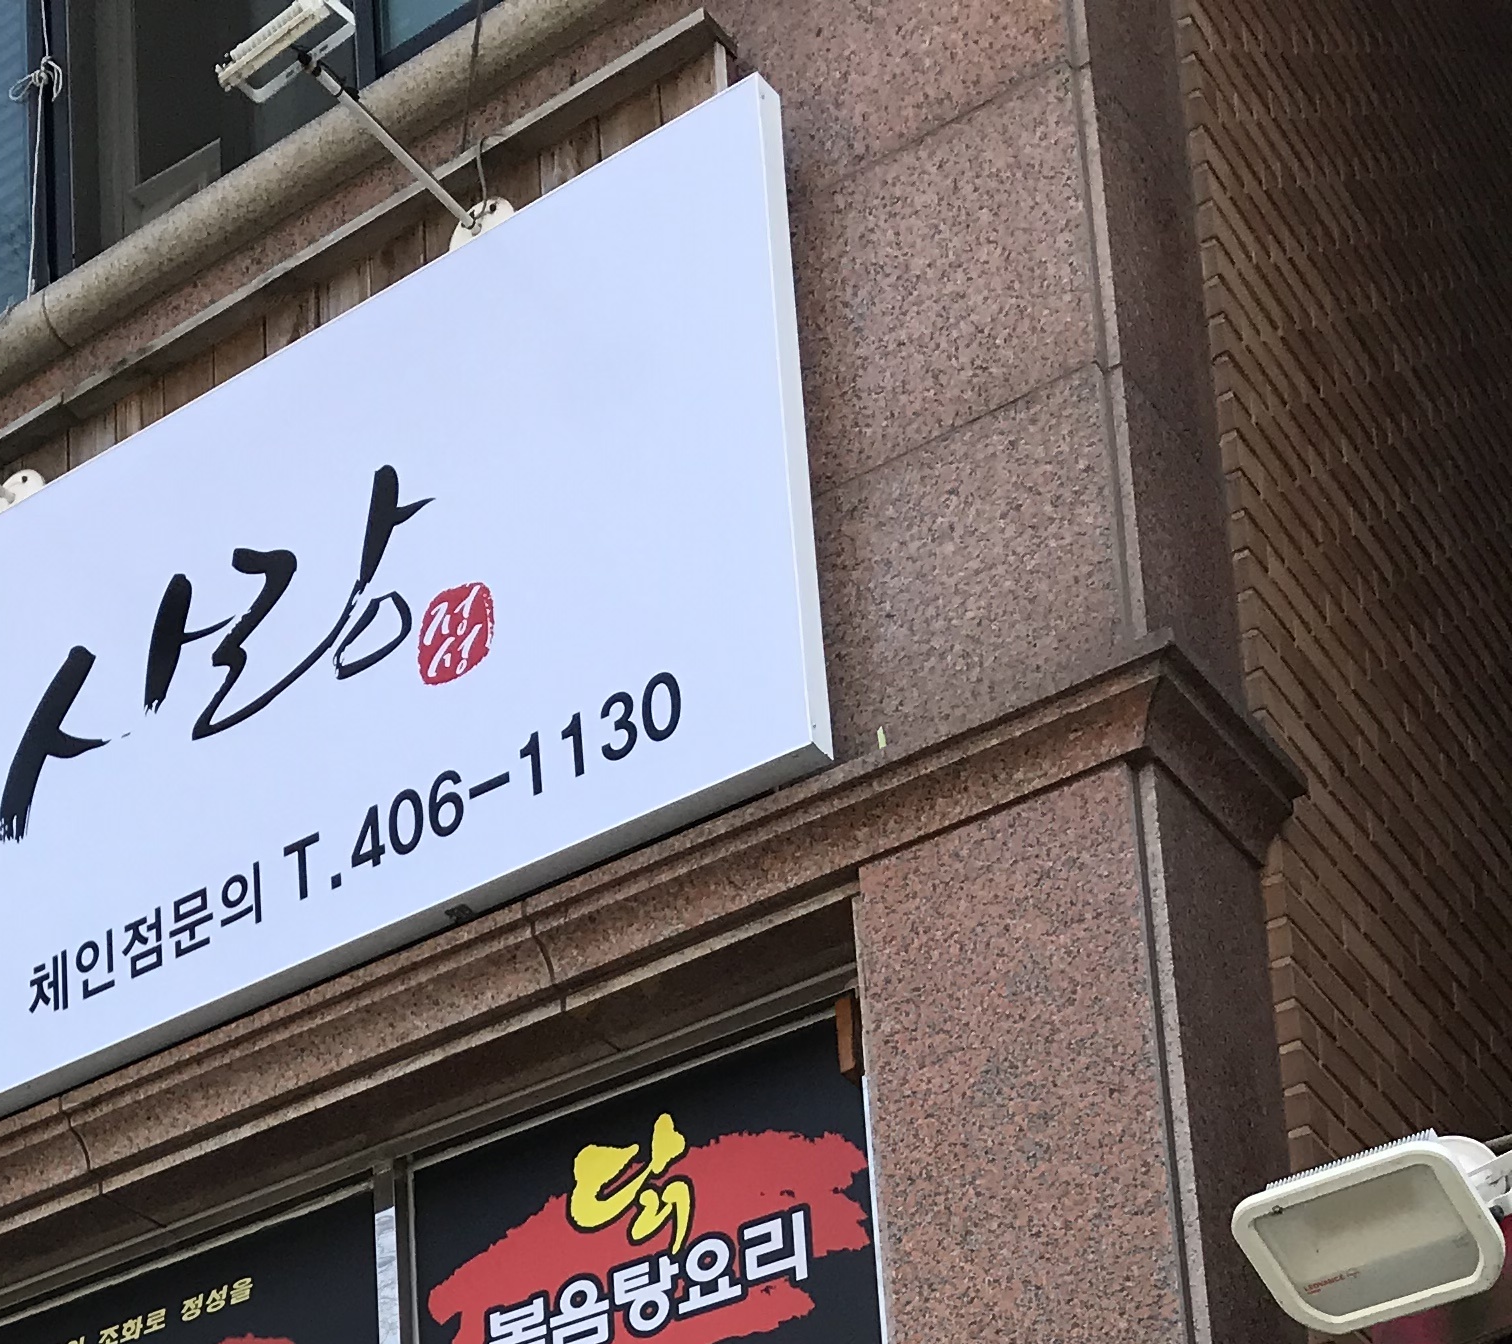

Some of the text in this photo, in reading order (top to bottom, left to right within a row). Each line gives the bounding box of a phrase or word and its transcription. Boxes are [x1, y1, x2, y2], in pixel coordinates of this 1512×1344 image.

[28, 671, 682, 1014] 체인점문의 T.406-1130
[180, 1276, 253, 1322] 정성을
